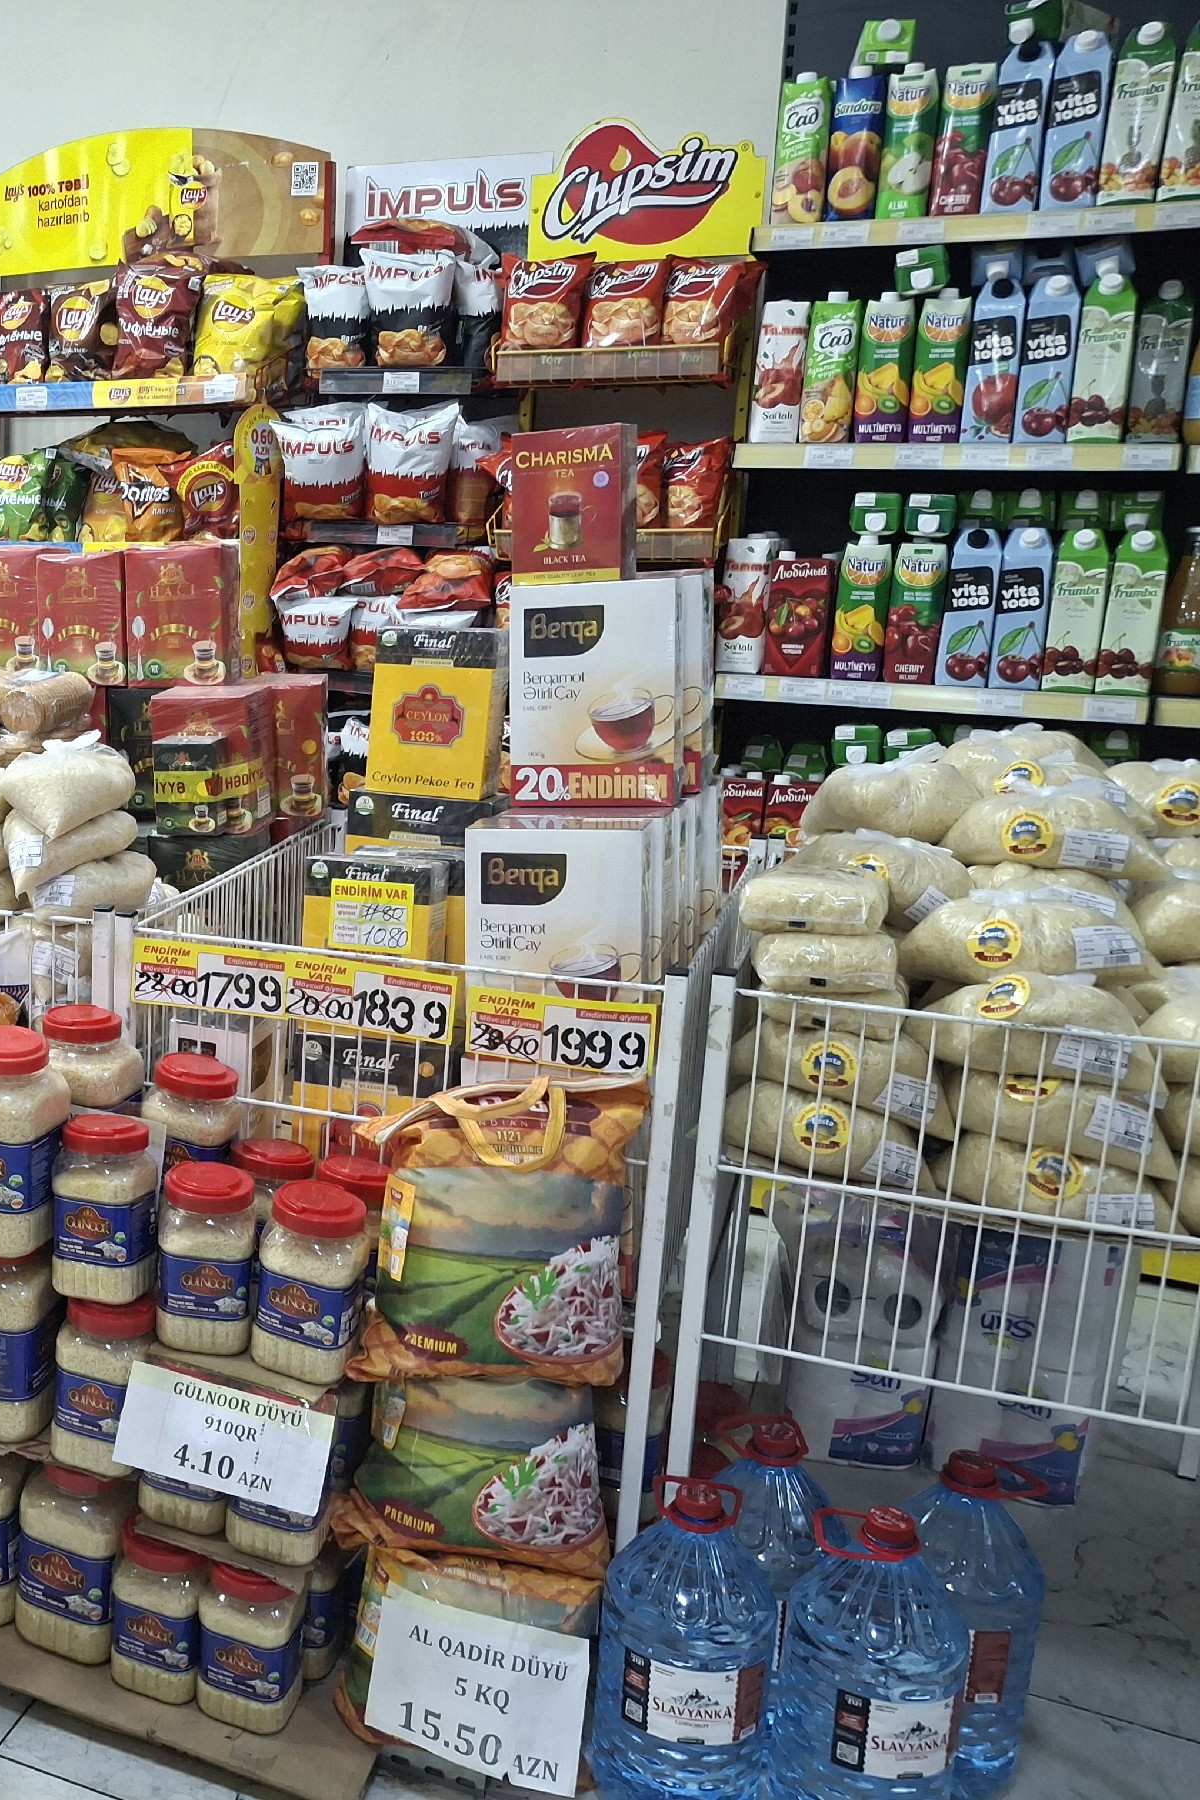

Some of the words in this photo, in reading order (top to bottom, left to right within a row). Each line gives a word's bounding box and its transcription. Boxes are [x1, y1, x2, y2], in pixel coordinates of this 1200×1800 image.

[27, 183, 55, 198] 100%
[542, 137, 738, 240] Chipsim
[38, 195, 88, 212] kartofdan
[515, 443, 614, 470] CHARISMA
[554, 468, 575, 479] TEA
[543, 555, 569, 566] BLACK
[570, 554, 587, 563] TEA
[773, 563, 827, 583] Любимый
[951, 584, 989, 600] vita
[1001, 584, 1040, 600] vita
[951, 594, 990, 609] 1000
[1001, 595, 1040, 610] 1000
[523, 671, 585, 687] Berqamot
[406, 709, 450, 723] CEYLON
[410, 730, 443, 743] 100%
[371, 771, 412, 787] Ceylon
[415, 774, 450, 788] Pekoe
[454, 778, 475, 790] Tea
[515, 766, 572, 802] 20%
[568, 766, 668, 800] ENDİRİM
[391, 801, 444, 823] Final
[334, 884, 382, 899] ENDİRİM
[385, 888, 408, 900] VAR
[479, 916, 548, 939] Berqamot
[143, 945, 191, 958] ENDİRİM
[155, 954, 179, 965] VAR
[294, 960, 347, 976] ENDİRİM
[308, 971, 333, 983] VAR
[478, 994, 536, 1010] ENDİRİM
[494, 1005, 521, 1017] VAR
[496, 1129, 523, 1143] 1121
[404, 1332, 458, 1357] PREMIUM
[173, 1380, 251, 1415] GÜLNOOR
[254, 1399, 303, 1428] DÜYÜ
[204, 1415, 258, 1443] 910QR
[172, 1442, 236, 1482] 4.10
[237, 1470, 273, 1493] AZN
[383, 1503, 437, 1536] PREMIUM
[409, 1624, 434, 1647] AL
[438, 1635, 505, 1669] QADİR
[511, 1655, 569, 1682] DÜYÜ
[454, 1676, 468, 1698] 5
[474, 1682, 511, 1715] KQ
[652, 1694, 733, 1722] SLAVYANKA
[398, 1700, 503, 1767] 15.50
[512, 1753, 559, 1783] AZN
[870, 1733, 948, 1756] SLAVYANKA
